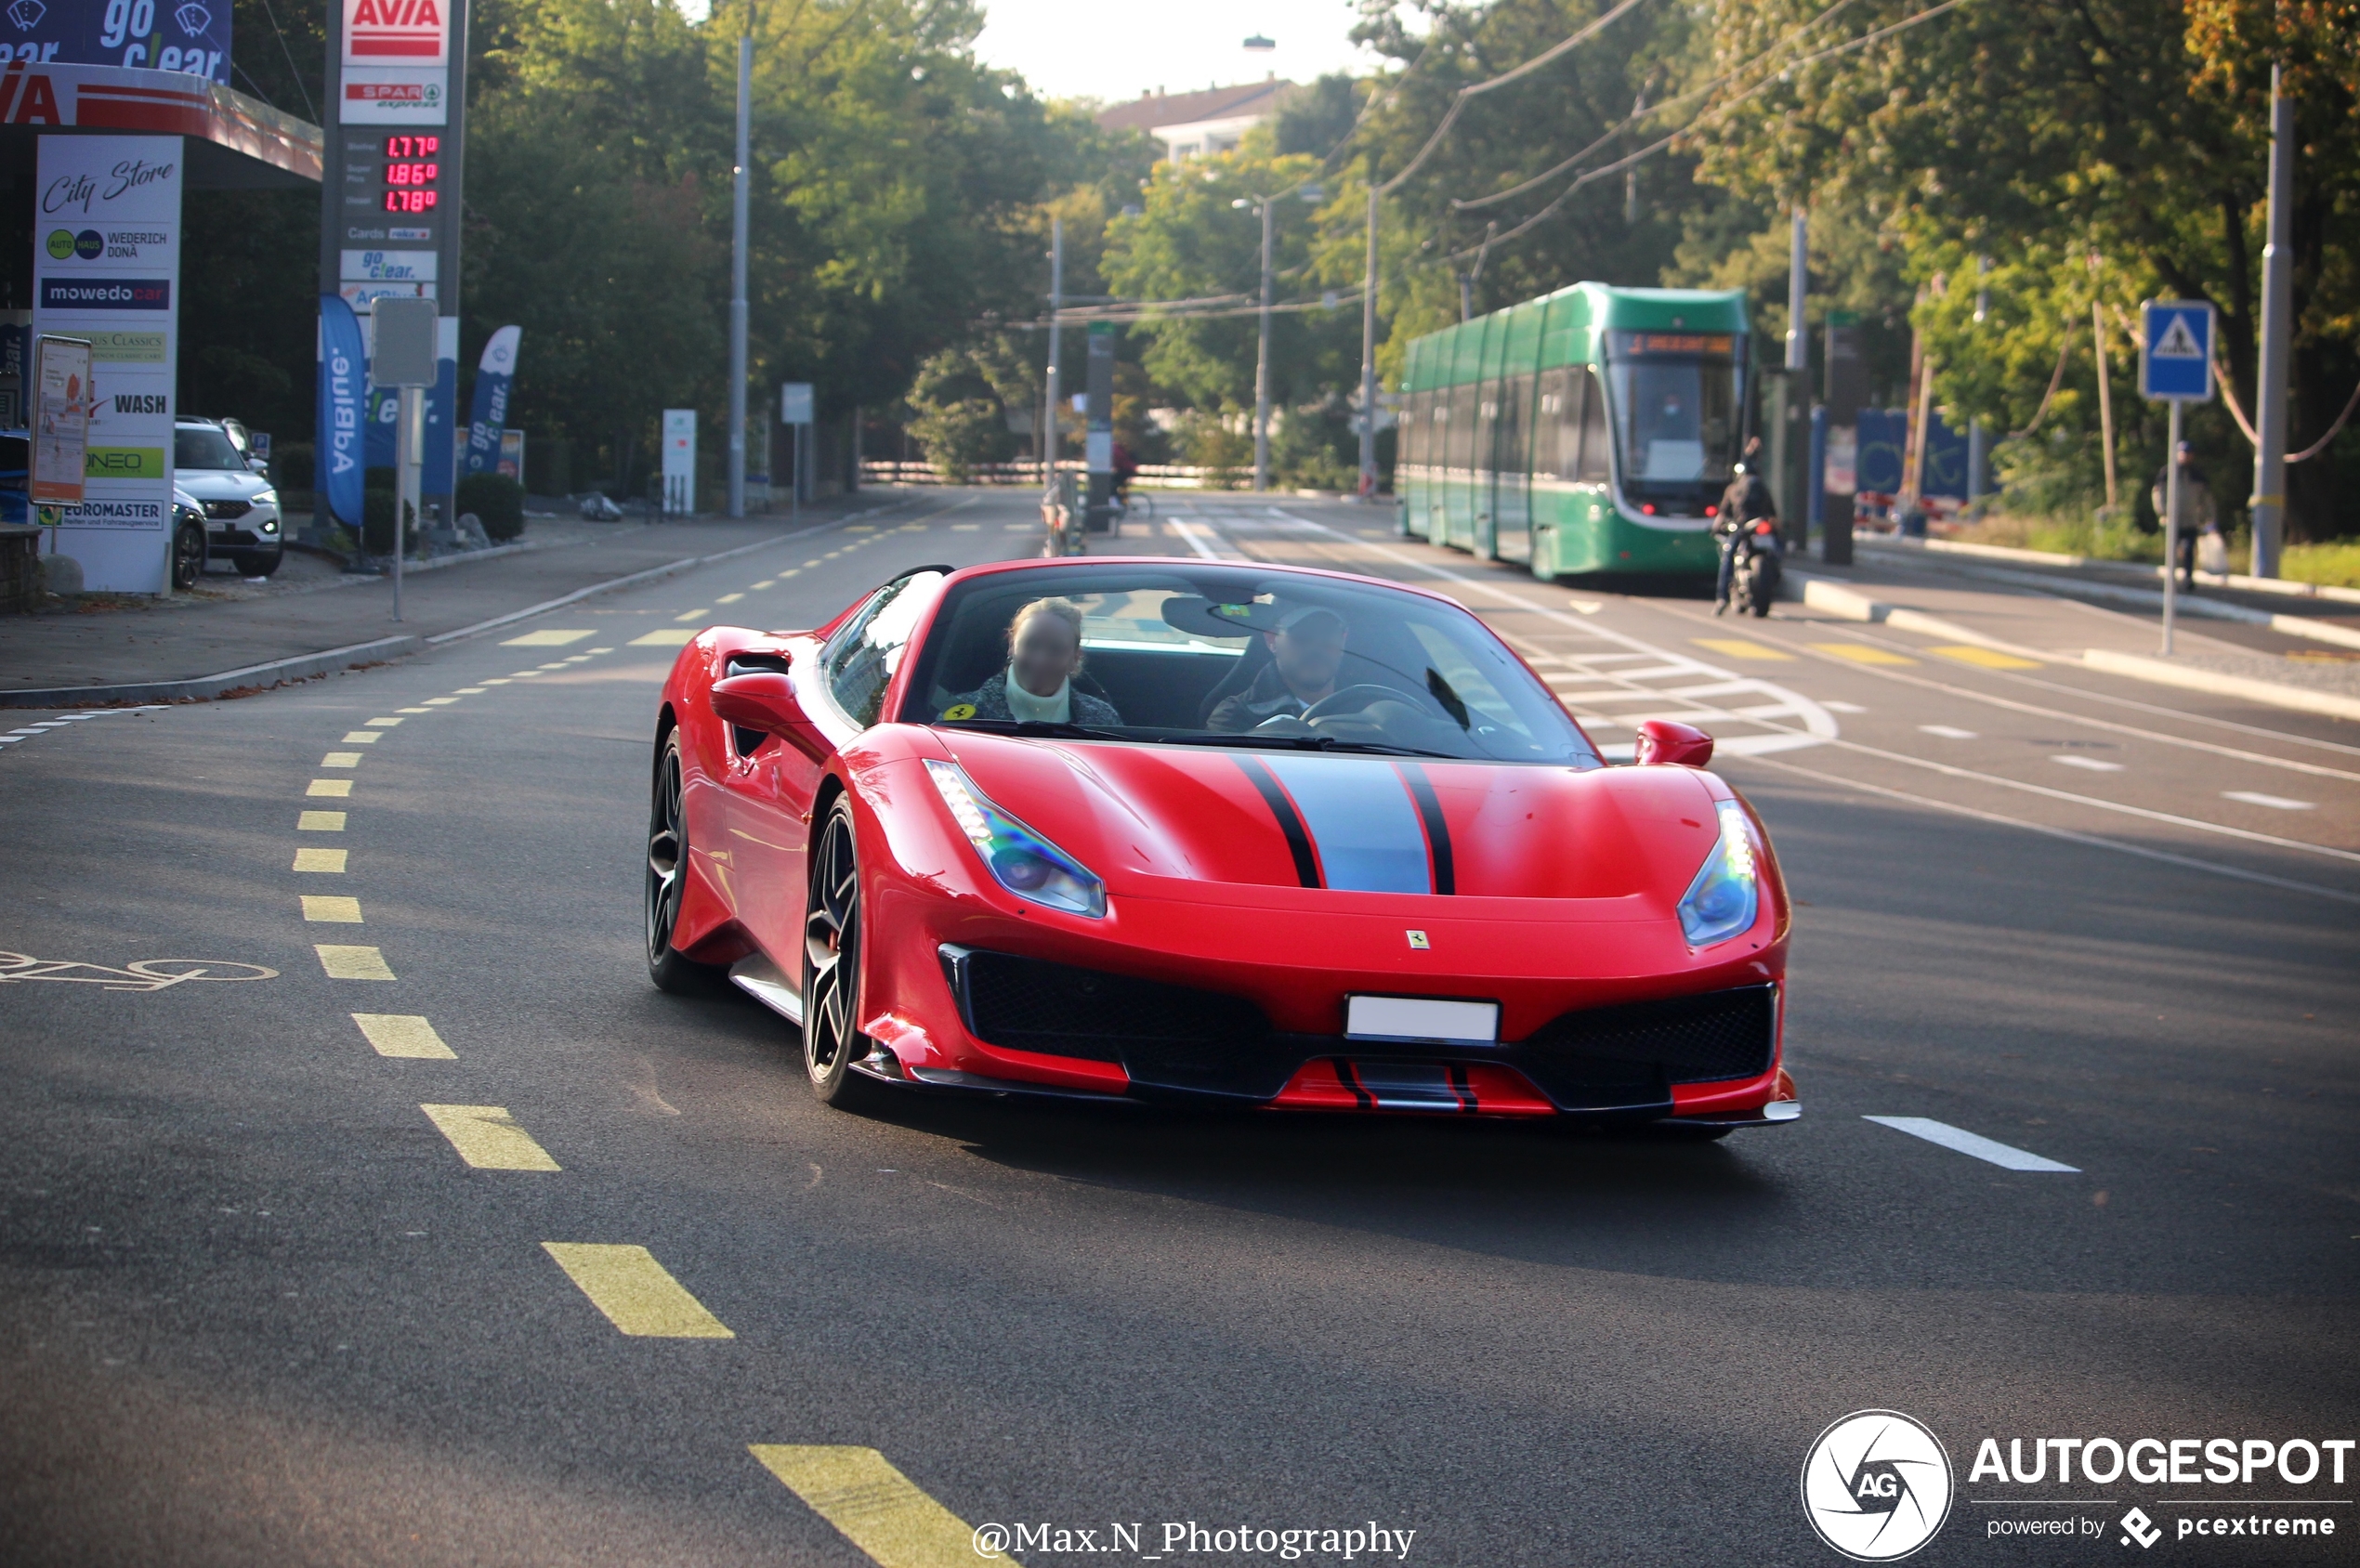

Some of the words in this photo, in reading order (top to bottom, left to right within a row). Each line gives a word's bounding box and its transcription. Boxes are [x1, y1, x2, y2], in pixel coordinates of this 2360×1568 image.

[352, 0, 439, 26] AVIA
[100, 0, 154, 47] go
[362, 86, 421, 98] SPAR
[43, 175, 98, 213] City
[102, 160, 174, 200] Store
[108, 232, 167, 244] WEDERICH
[347, 228, 385, 239] Cards
[50, 241, 72, 249] AUTO
[77, 241, 100, 249] HAUS
[362, 252, 383, 268] go
[114, 394, 166, 414] WASH
[471, 422, 490, 451] go
[85, 452, 141, 469] NEO
[64, 503, 159, 517] EUROMASTER
[103, 518, 159, 528] Fahrzeugservice
